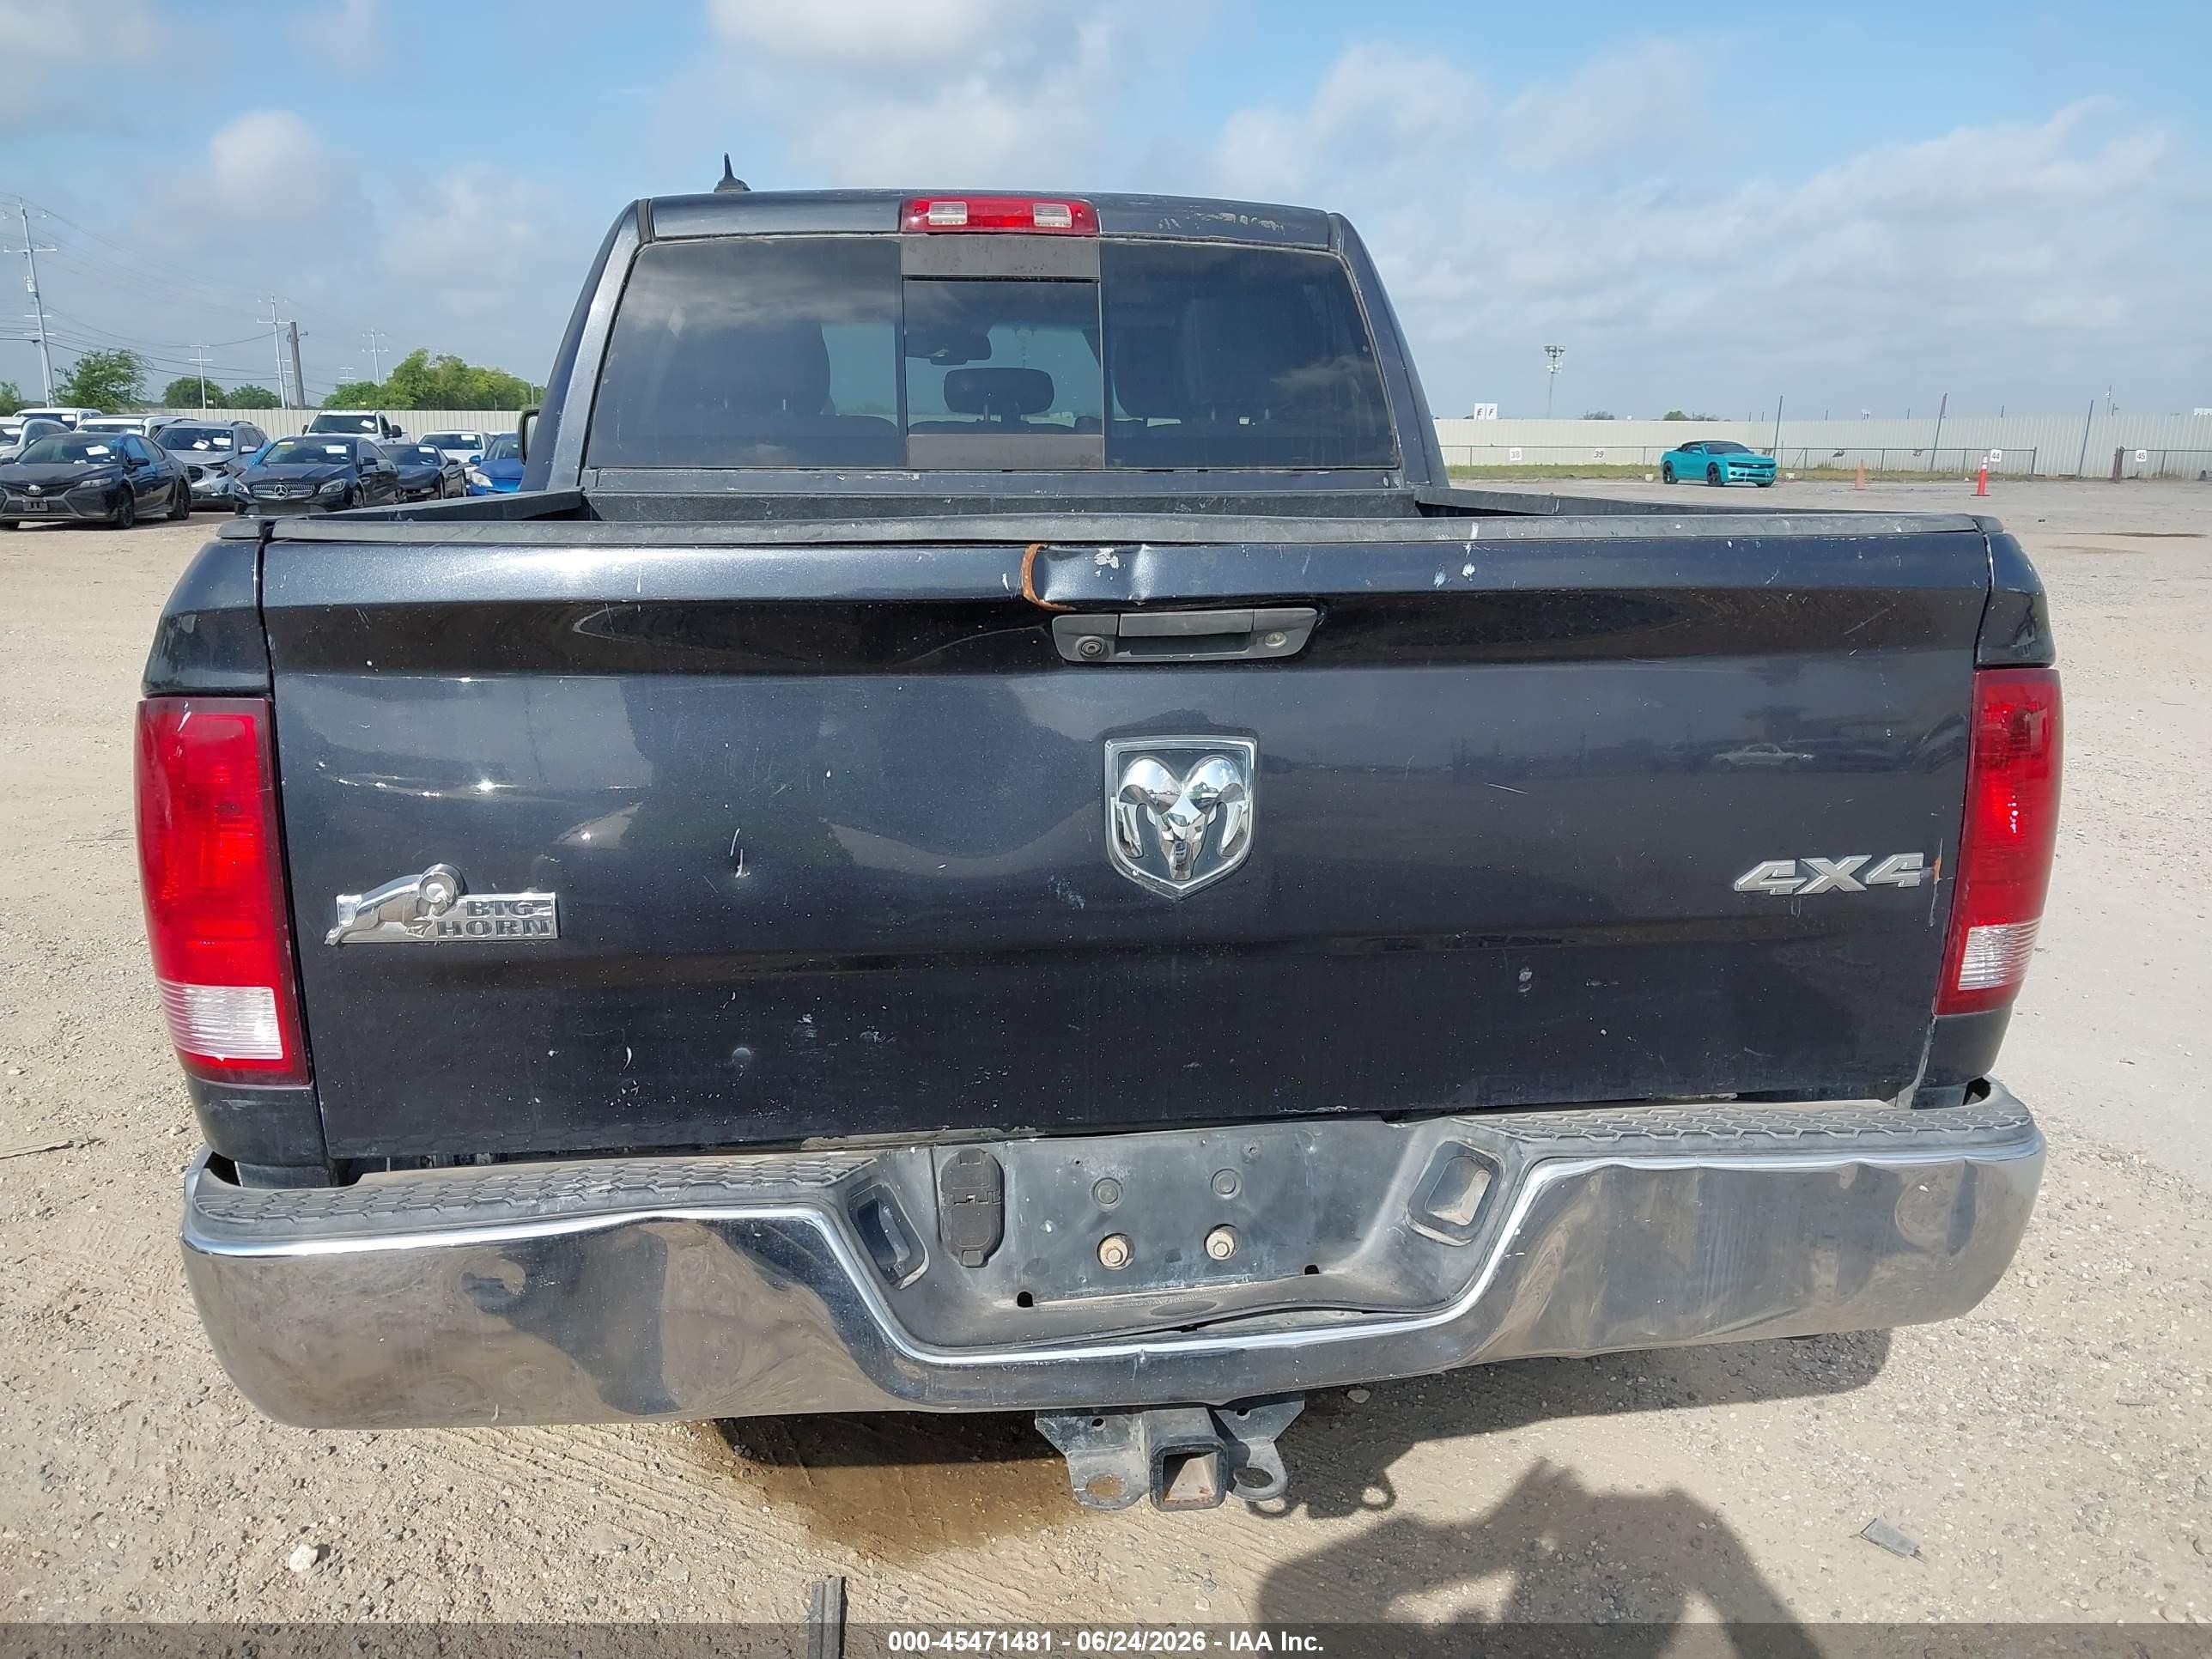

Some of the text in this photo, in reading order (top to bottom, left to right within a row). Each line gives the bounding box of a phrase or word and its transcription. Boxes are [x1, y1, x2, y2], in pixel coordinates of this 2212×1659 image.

[1510, 450, 1521, 459] 38
[1594, 450, 1604, 459] 39
[1991, 452, 2000, 460] 44
[466, 900, 552, 918] BIG
[437, 920, 550, 938] HORN
